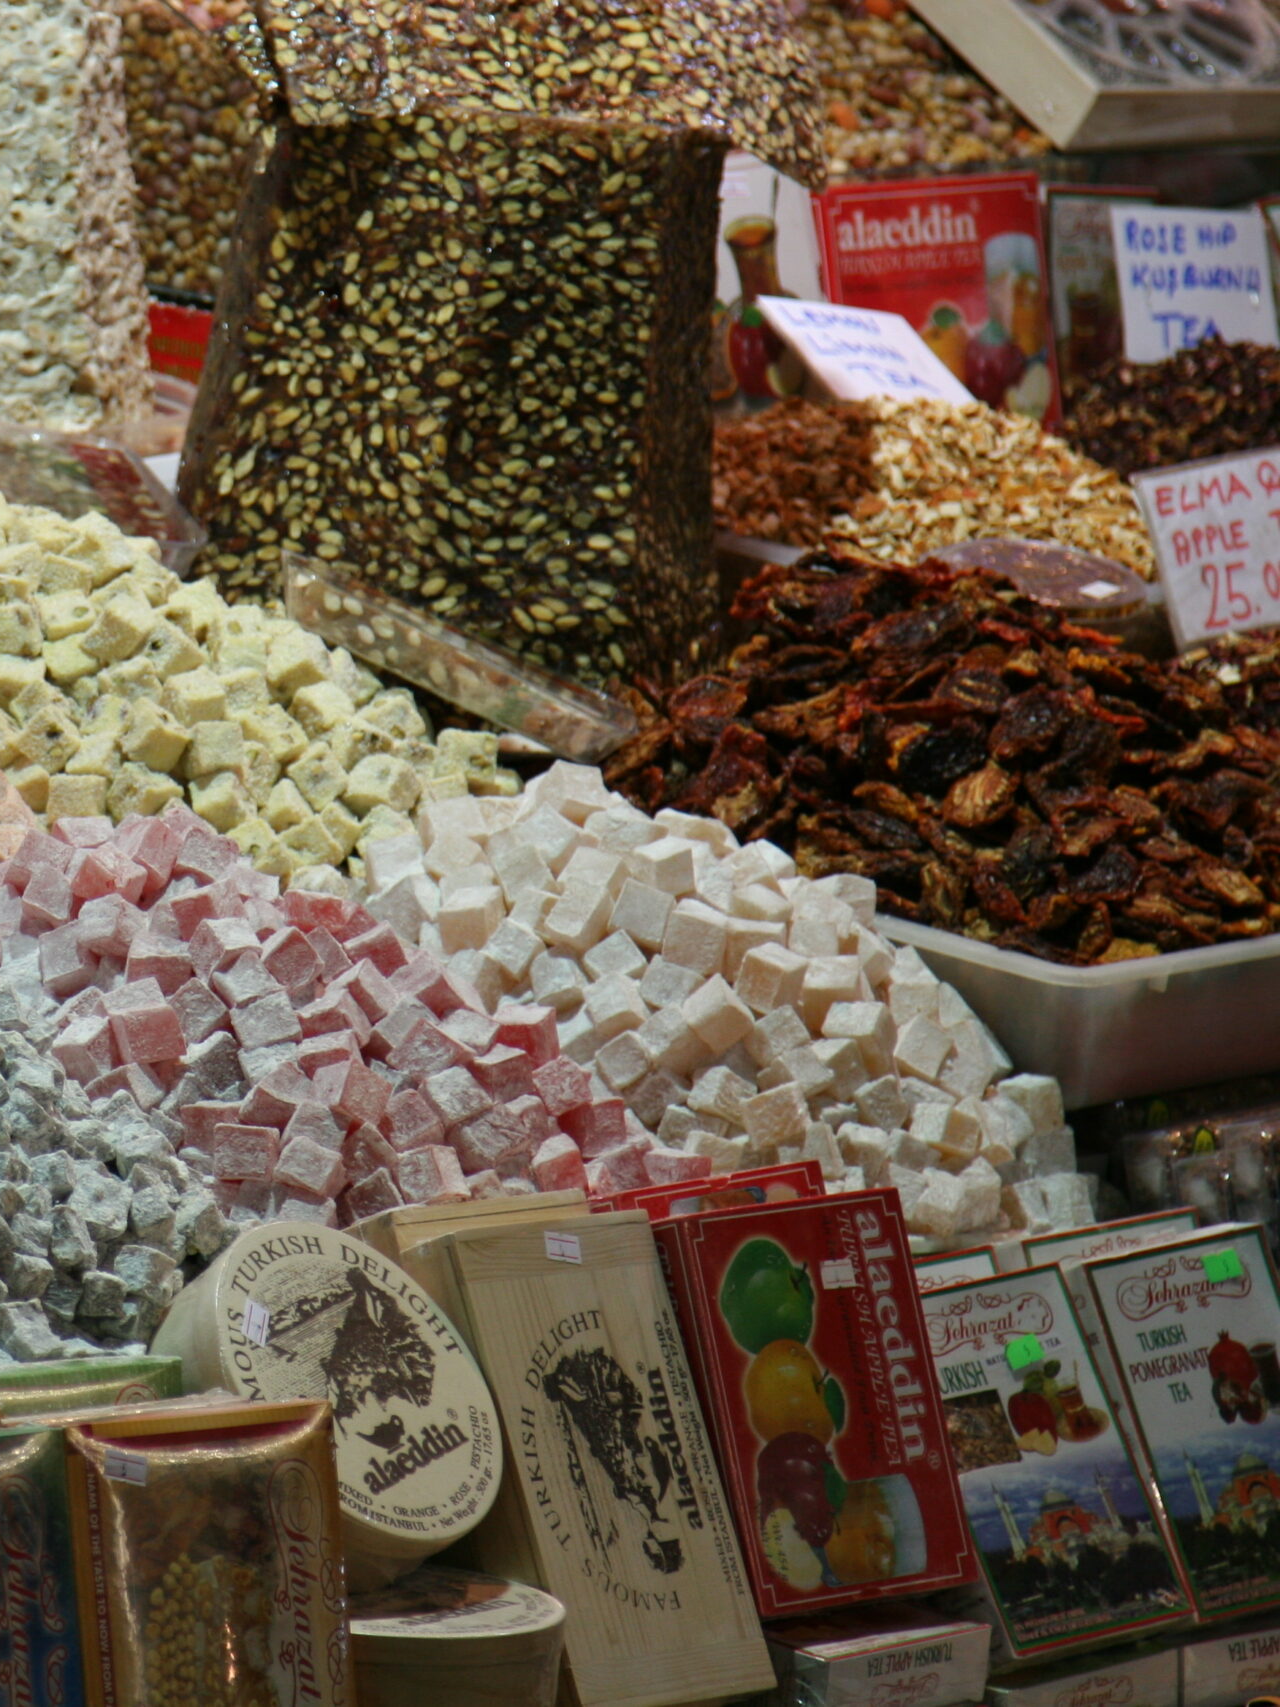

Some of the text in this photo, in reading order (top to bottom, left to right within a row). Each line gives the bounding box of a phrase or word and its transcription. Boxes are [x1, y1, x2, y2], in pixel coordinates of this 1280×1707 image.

[837, 205, 978, 251] alaeddin
[1125, 217, 1187, 255] ROSE
[1151, 311, 1216, 350] TEA
[1154, 470, 1253, 518] ELMA
[1171, 519, 1250, 567] APPLE
[230, 1235, 326, 1296] TURKISH
[340, 1243, 463, 1356] DELIGHT
[525, 1309, 601, 1391] DELIGHT
[856, 1211, 926, 1466] alaeddin
[1136, 1323, 1188, 1353] TURKISH
[654, 1320, 681, 1397] PISTACHIO
[939, 1360, 989, 1395] URKISH
[864, 1327, 892, 1410] APPLE
[881, 1417, 901, 1466] TEA
[1168, 1382, 1194, 1405] TEA
[363, 1423, 470, 1495] alaeddin
[393, 1506, 440, 1519] ORANGE
[449, 1481, 472, 1507] ROSE
[469, 1405, 482, 1470] PISTACHIO
[647, 1368, 704, 1531] alaeddin
[86, 1473, 97, 1510] NAME
[521, 1405, 572, 1551] TURKISH
[89, 1513, 98, 1528] OF
[340, 1492, 369, 1517] ROM
[370, 1508, 430, 1532] ISTANBUL
[90, 1534, 100, 1555] THE
[92, 1560, 104, 1593] TASTE
[582, 1557, 682, 1612] FAMOUS
[96, 1599, 106, 1615] TO
[97, 1619, 109, 1652] NOW
[1227, 1642, 1248, 1663] TEA
[100, 1656, 112, 1692] FROM
[867, 1643, 953, 1679] TURKISH APPLE TEA
